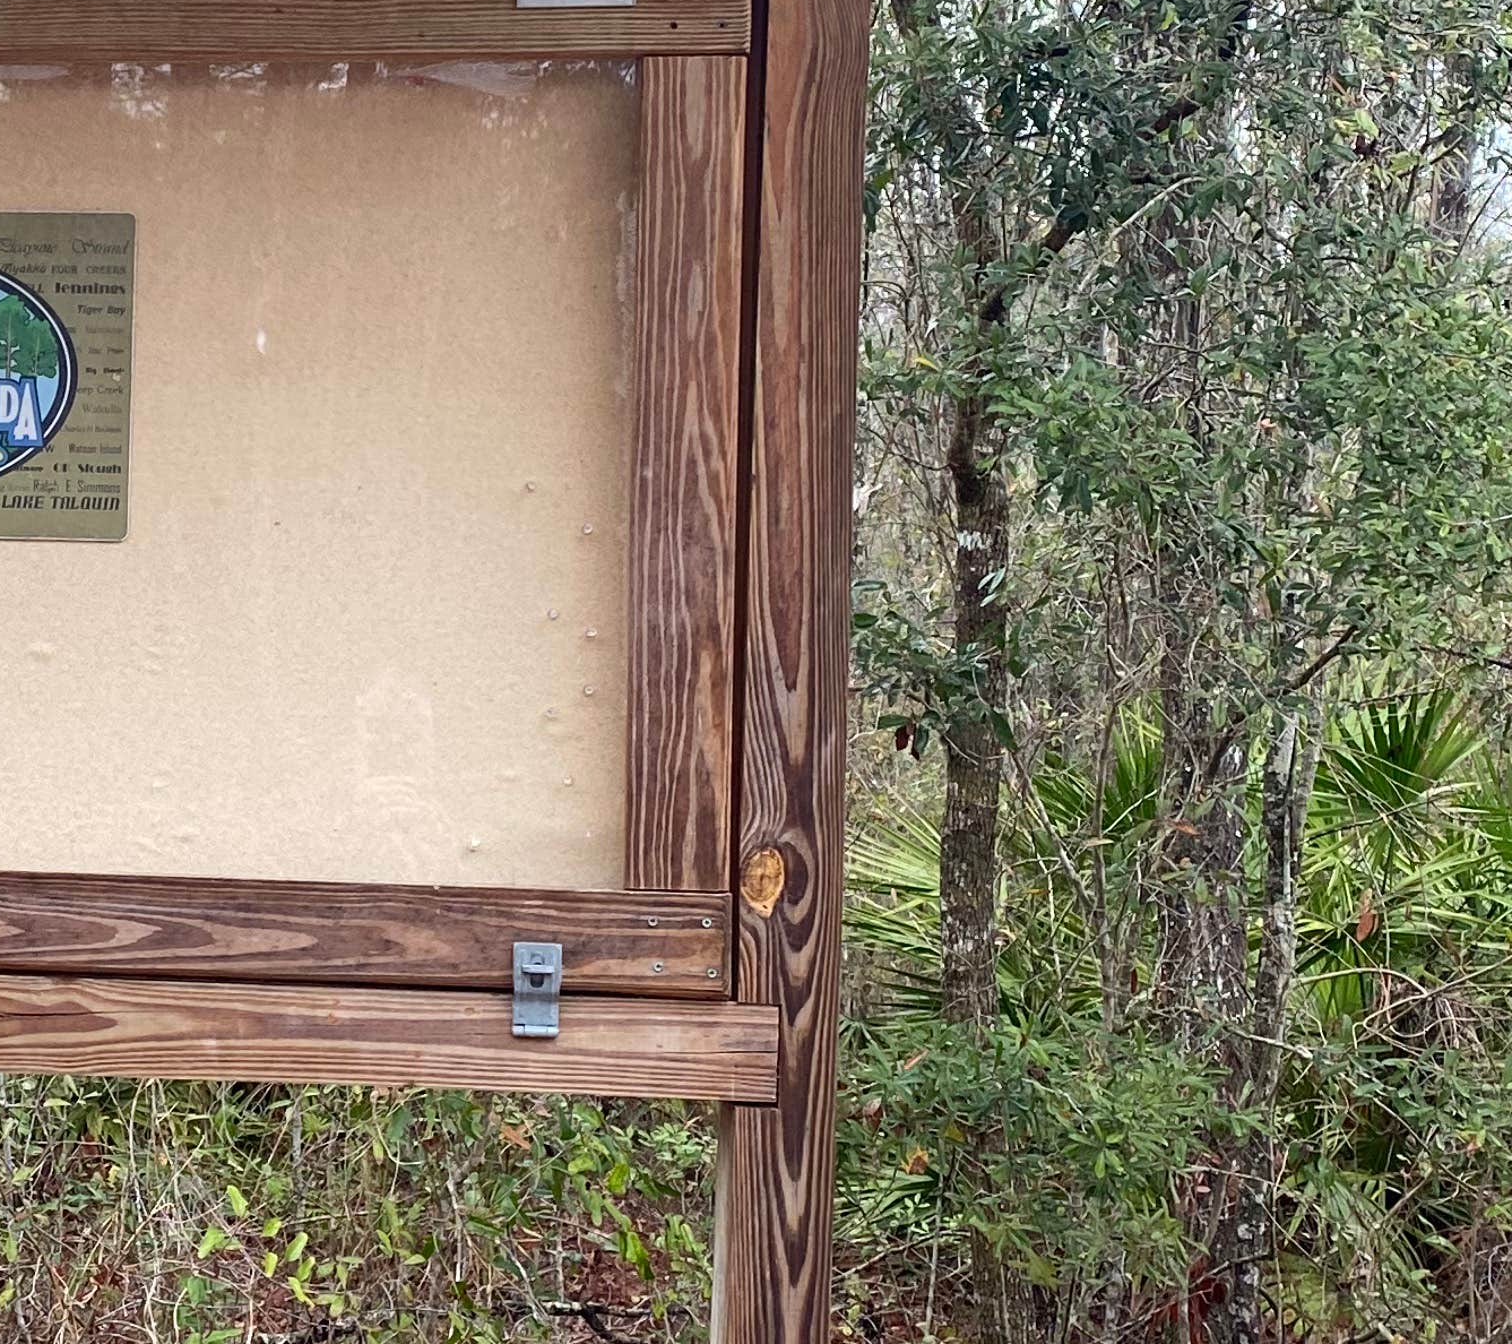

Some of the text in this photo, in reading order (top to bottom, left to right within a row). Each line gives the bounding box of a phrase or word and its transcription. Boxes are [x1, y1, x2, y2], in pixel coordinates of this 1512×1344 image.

[55, 282, 126, 294] Jennings
[77, 304, 126, 316] Tiger Bay
[1, 494, 121, 511] LAKE TALQUIN
